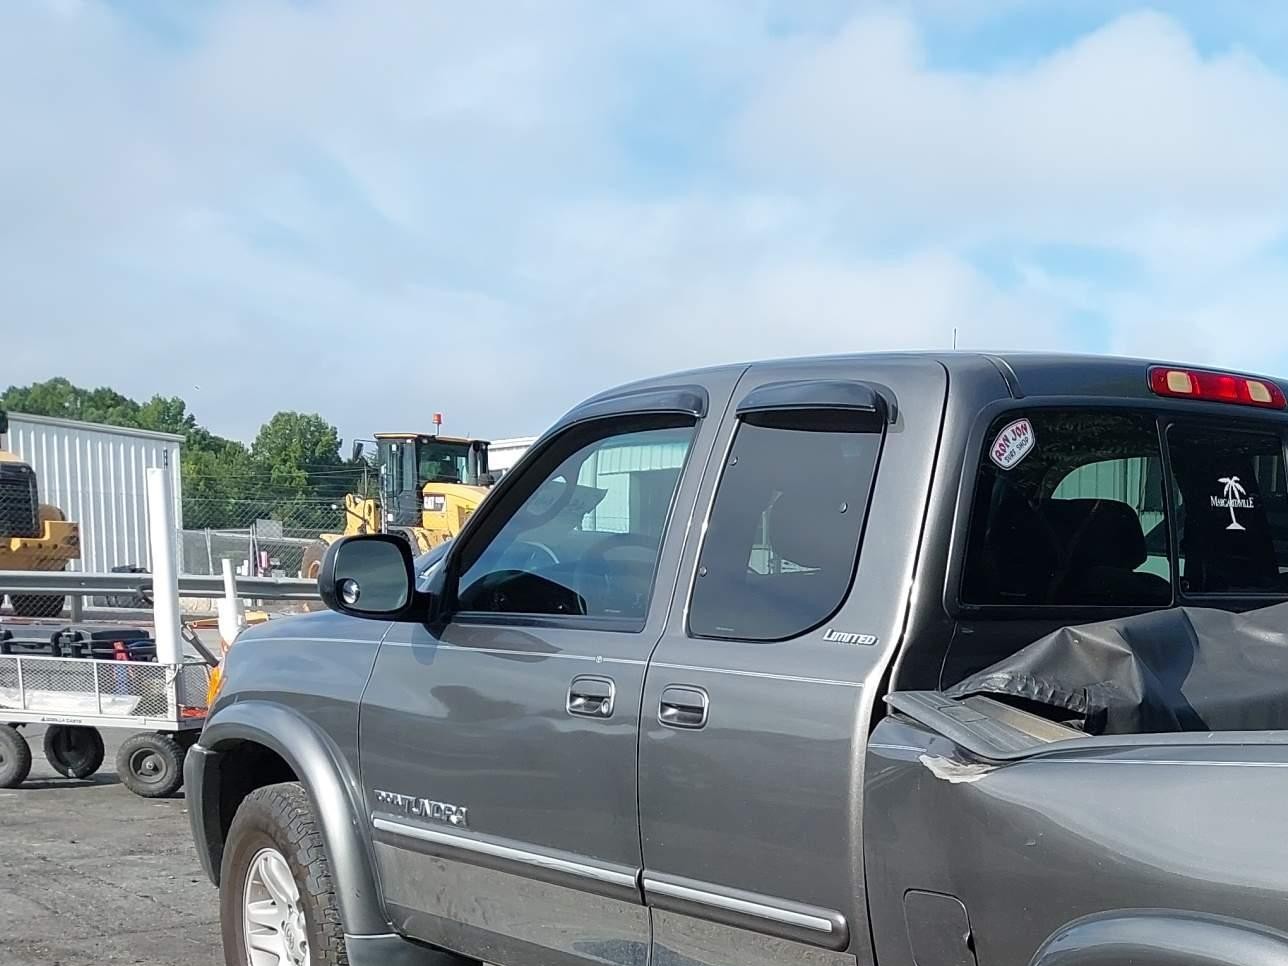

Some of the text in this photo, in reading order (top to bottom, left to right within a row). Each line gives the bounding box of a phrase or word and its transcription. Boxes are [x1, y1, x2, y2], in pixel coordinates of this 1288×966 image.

[995, 423, 1029, 462] RON JON
[1004, 437, 1029, 463] SURF SHOP
[401, 794, 469, 827] TUNDRA
